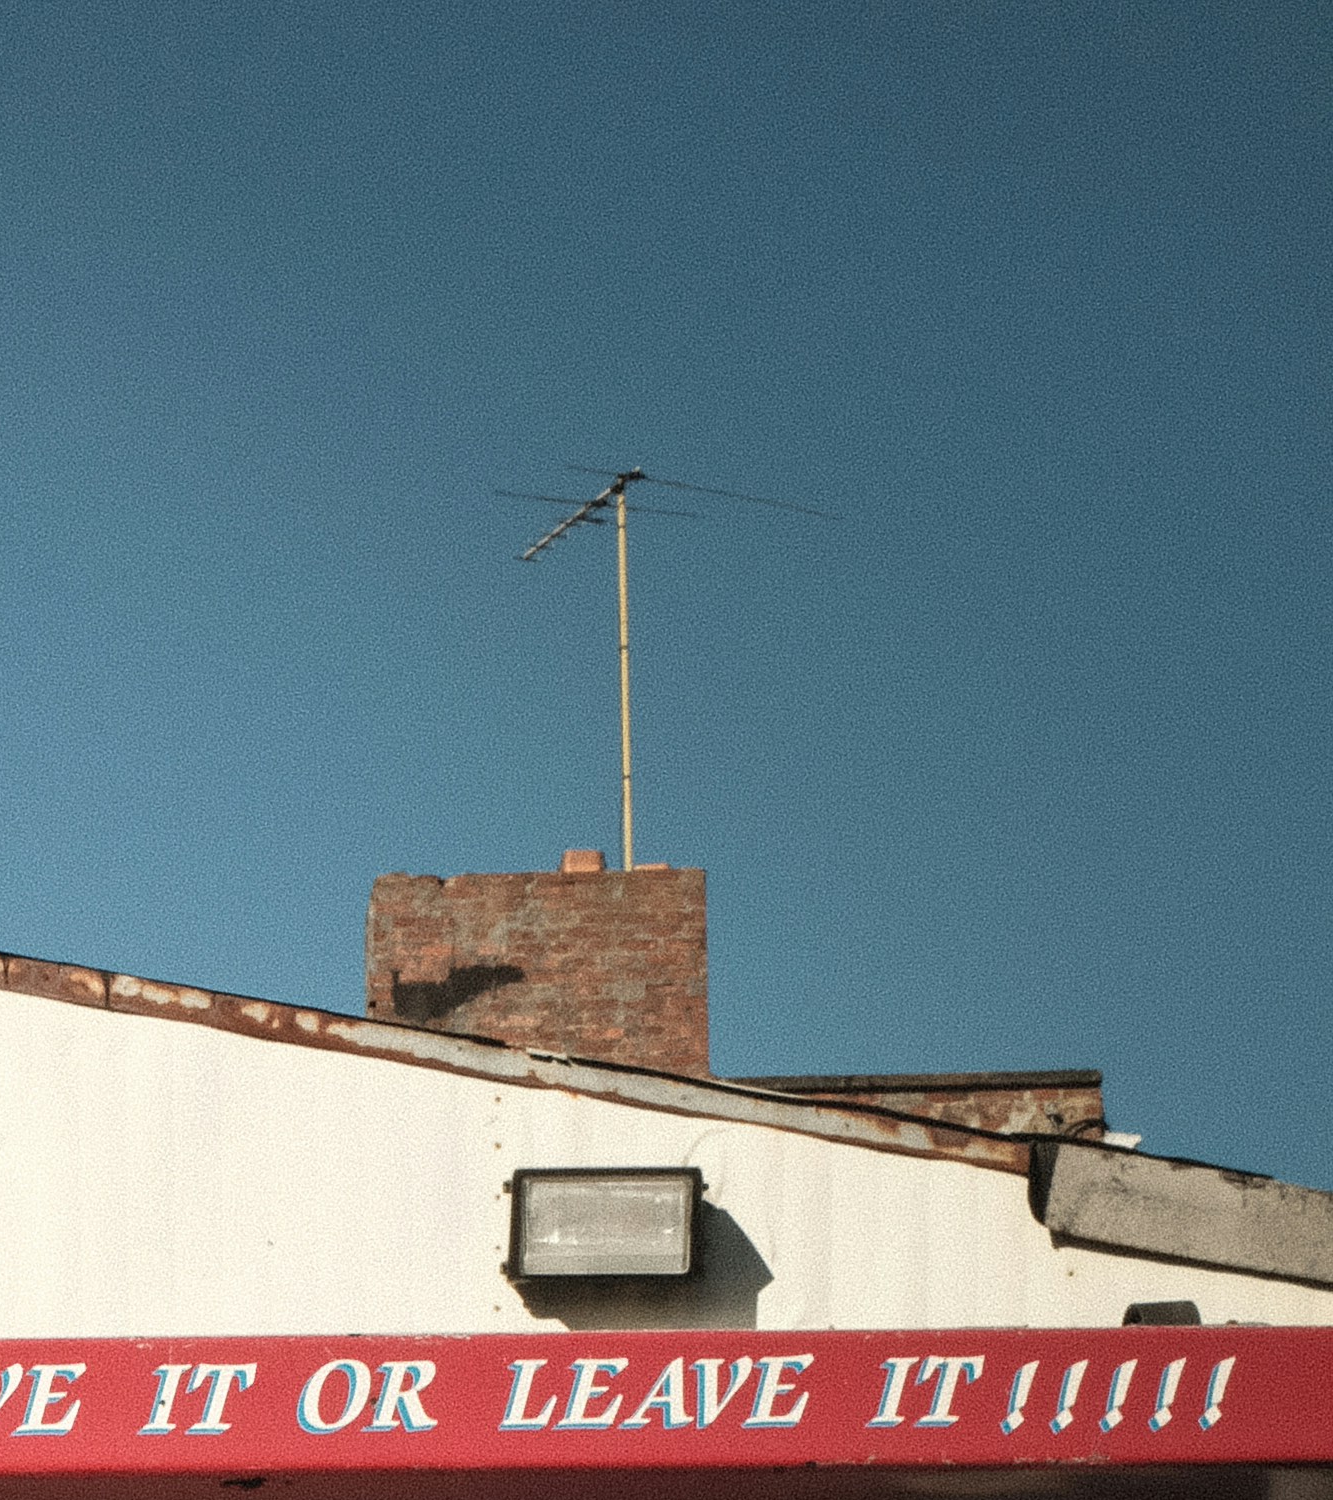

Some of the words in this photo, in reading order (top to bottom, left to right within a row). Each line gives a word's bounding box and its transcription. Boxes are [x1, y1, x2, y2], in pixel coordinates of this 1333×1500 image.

[136, 1361, 258, 1436] IT
[294, 1357, 440, 1435] OR
[497, 1352, 815, 1432] LEAVE
